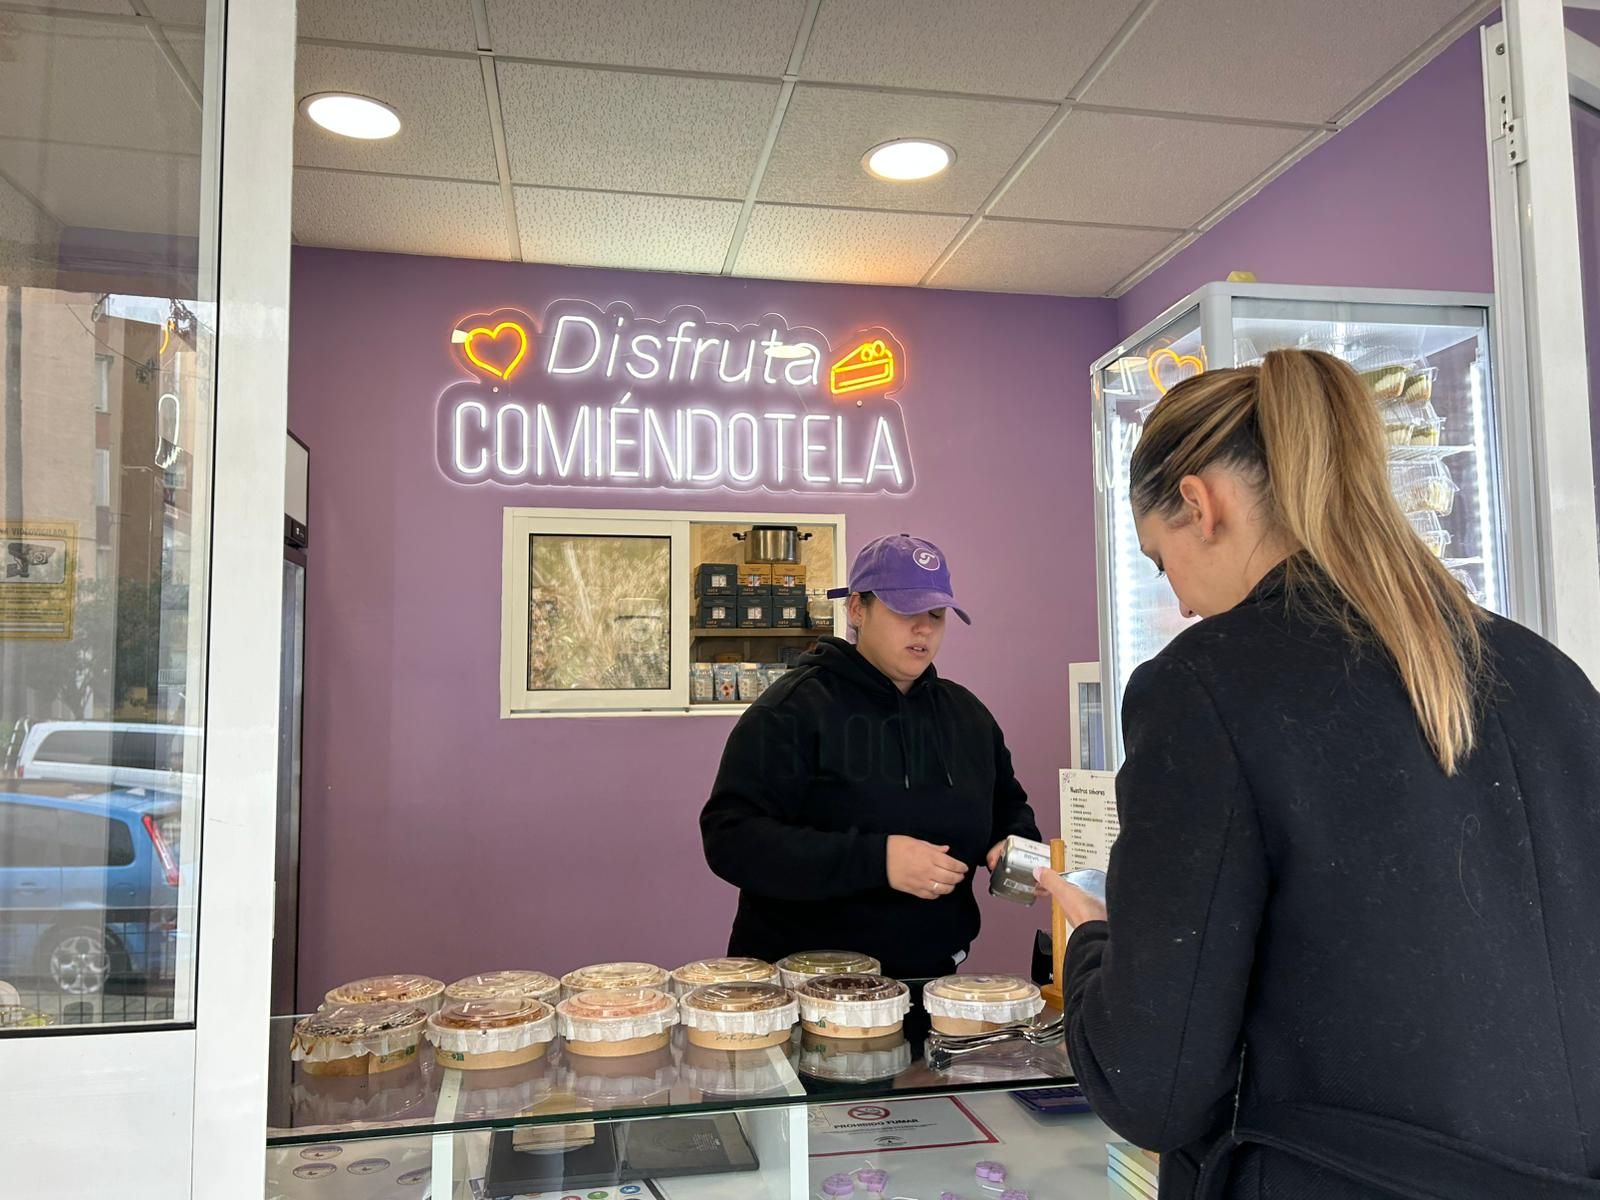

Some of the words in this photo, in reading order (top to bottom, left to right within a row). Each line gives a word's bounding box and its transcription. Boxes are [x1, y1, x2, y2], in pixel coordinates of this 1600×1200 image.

[547, 315, 822, 386] Disfruta
[454, 392, 903, 485] COMIÉNDOTELA
[833, 1120, 885, 1129] PROHIBIDO
